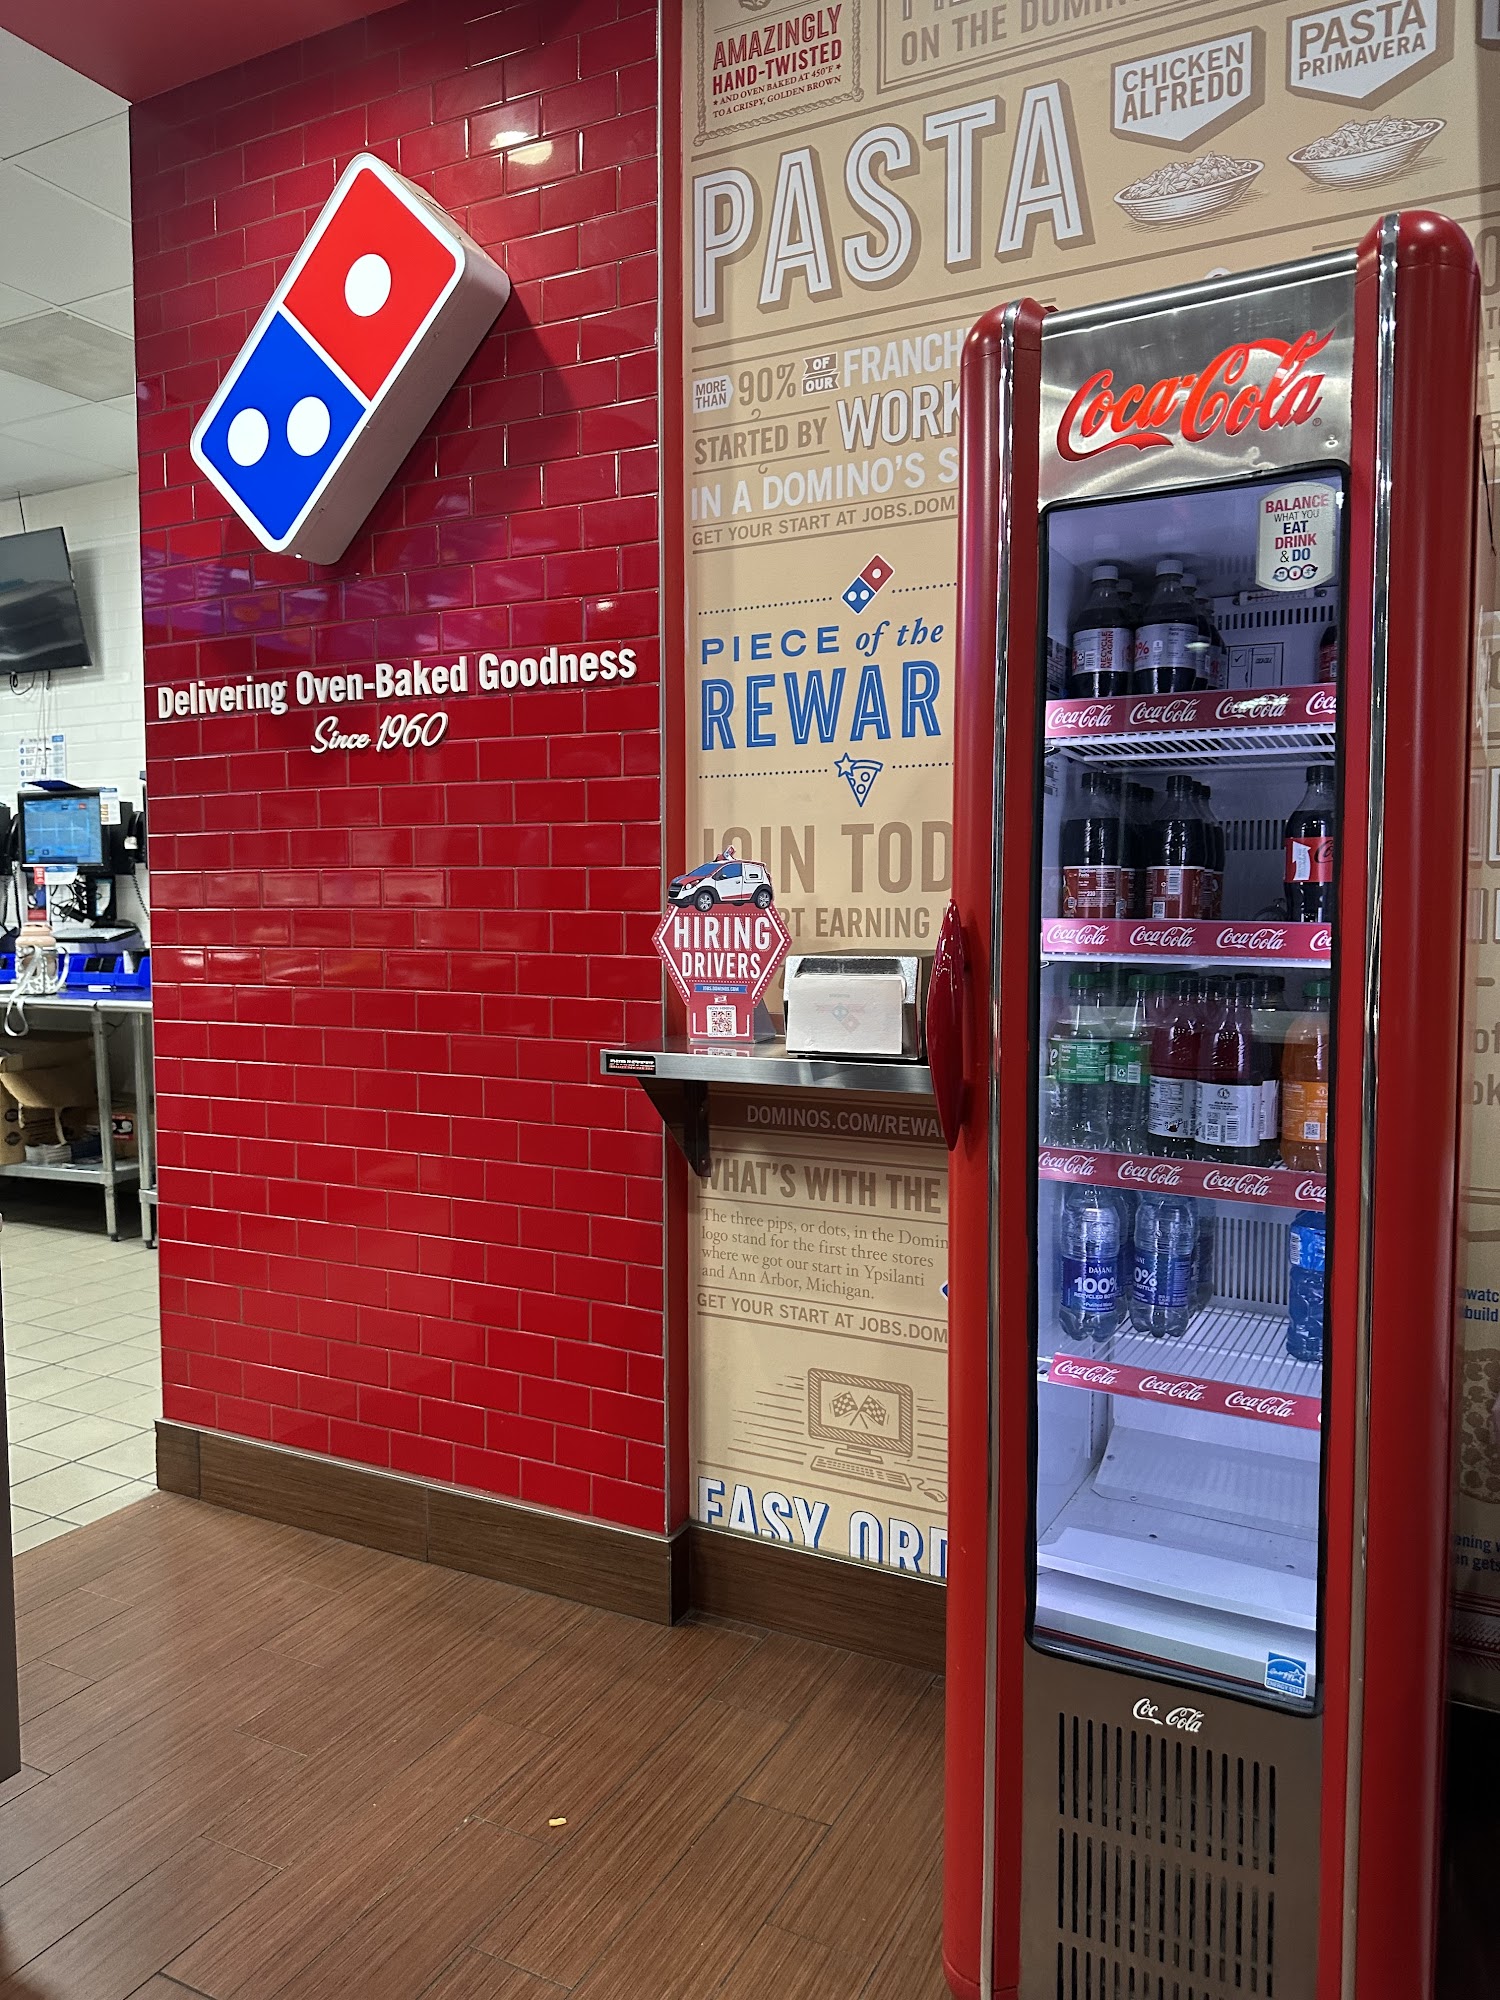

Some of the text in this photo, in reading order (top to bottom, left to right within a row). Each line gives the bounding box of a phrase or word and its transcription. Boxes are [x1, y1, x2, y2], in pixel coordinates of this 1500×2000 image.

[713, 4, 842, 70] AMAZINGLY
[901, 24, 940, 66] ON
[952, 5, 1008, 51] THE
[1299, 2, 1426, 58] PASTA
[713, 39, 842, 95] HAND-TWISTED
[1122, 41, 1245, 92] CHICKEN
[1299, 33, 1426, 79] PRIMAVERA
[713, 109, 726, 118] TO
[733, 98, 766, 113] CRISPY,
[767, 86, 805, 103] GOLDEN
[807, 75, 842, 92] BROWN
[720, 94, 739, 104] AND
[741, 85, 766, 98] OVEN
[767, 76, 797, 91] BAKED
[798, 72, 811, 82] AT
[1122, 67, 1244, 123] ALFREDO
[692, 79, 1095, 327] PASTA
[812, 357, 830, 371] OF
[695, 379, 727, 397] MORE
[738, 362, 797, 406] 90%
[805, 377, 833, 392] OUR
[1057, 327, 1337, 462] Coca-Cola
[695, 395, 727, 409] THAN
[694, 424, 789, 465] STARTED
[798, 417, 827, 448] BY
[691, 485, 721, 521] IN
[731, 480, 752, 515] A
[763, 452, 925, 511] DOMINO'S
[1265, 494, 1329, 513] BALANCE
[692, 495, 955, 545] GET YOUR START AT JOBS.DOM
[1274, 509, 1319, 522] WHAT YOU
[1283, 520, 1308, 534] EAT
[1275, 533, 1317, 549] DRINK
[1280, 548, 1311, 562] & DO
[702, 617, 944, 665] PIECE of the
[157, 646, 637, 720] Delivering Oven-Baked Goodness
[702, 660, 942, 750] REWAR
[1048, 704, 1115, 730] Coca-Cola
[1129, 699, 1201, 725] Coca-Cola
[310, 711, 449, 753] Since 1960
[673, 916, 772, 951] HIRING
[816, 907, 930, 939] EARNING
[1047, 924, 1109, 946] Coca-Cola
[1130, 926, 1197, 948] Coca-Cola
[1216, 928, 1288, 950] Coca-Cola
[682, 952, 761, 979] DRIVERS
[1038, 1151, 1096, 1176] Coca-Cola
[1118, 1160, 1184, 1187] Coca-Cola
[701, 1158, 941, 1214] WHAT'S WITH THE
[1203, 1169, 1273, 1197] Coca-Cola
[702, 1208, 727, 1223] The
[731, 1213, 764, 1227] three
[767, 1218, 797, 1233] pips,
[801, 1223, 814, 1233] or
[818, 1221, 850, 1239] dots,
[855, 1226, 867, 1239] in
[871, 1229, 894, 1243] the
[702, 1227, 934, 1267] logo stand for the first three stores
[702, 1247, 924, 1286] where we got our start in Ypsilanti
[702, 1265, 874, 1300] and Ann Arbor, Michigan.
[697, 1293, 947, 1344] GET YOUR START AT JOBS.DOM
[1054, 1360, 1121, 1386] Coca-Cola
[1138, 1375, 1208, 1402] Coca-Cola
[1225, 1391, 1297, 1418] Coca-Cola
[698, 1477, 830, 1549] EASY
[1166, 1706, 1205, 1733] Cola
